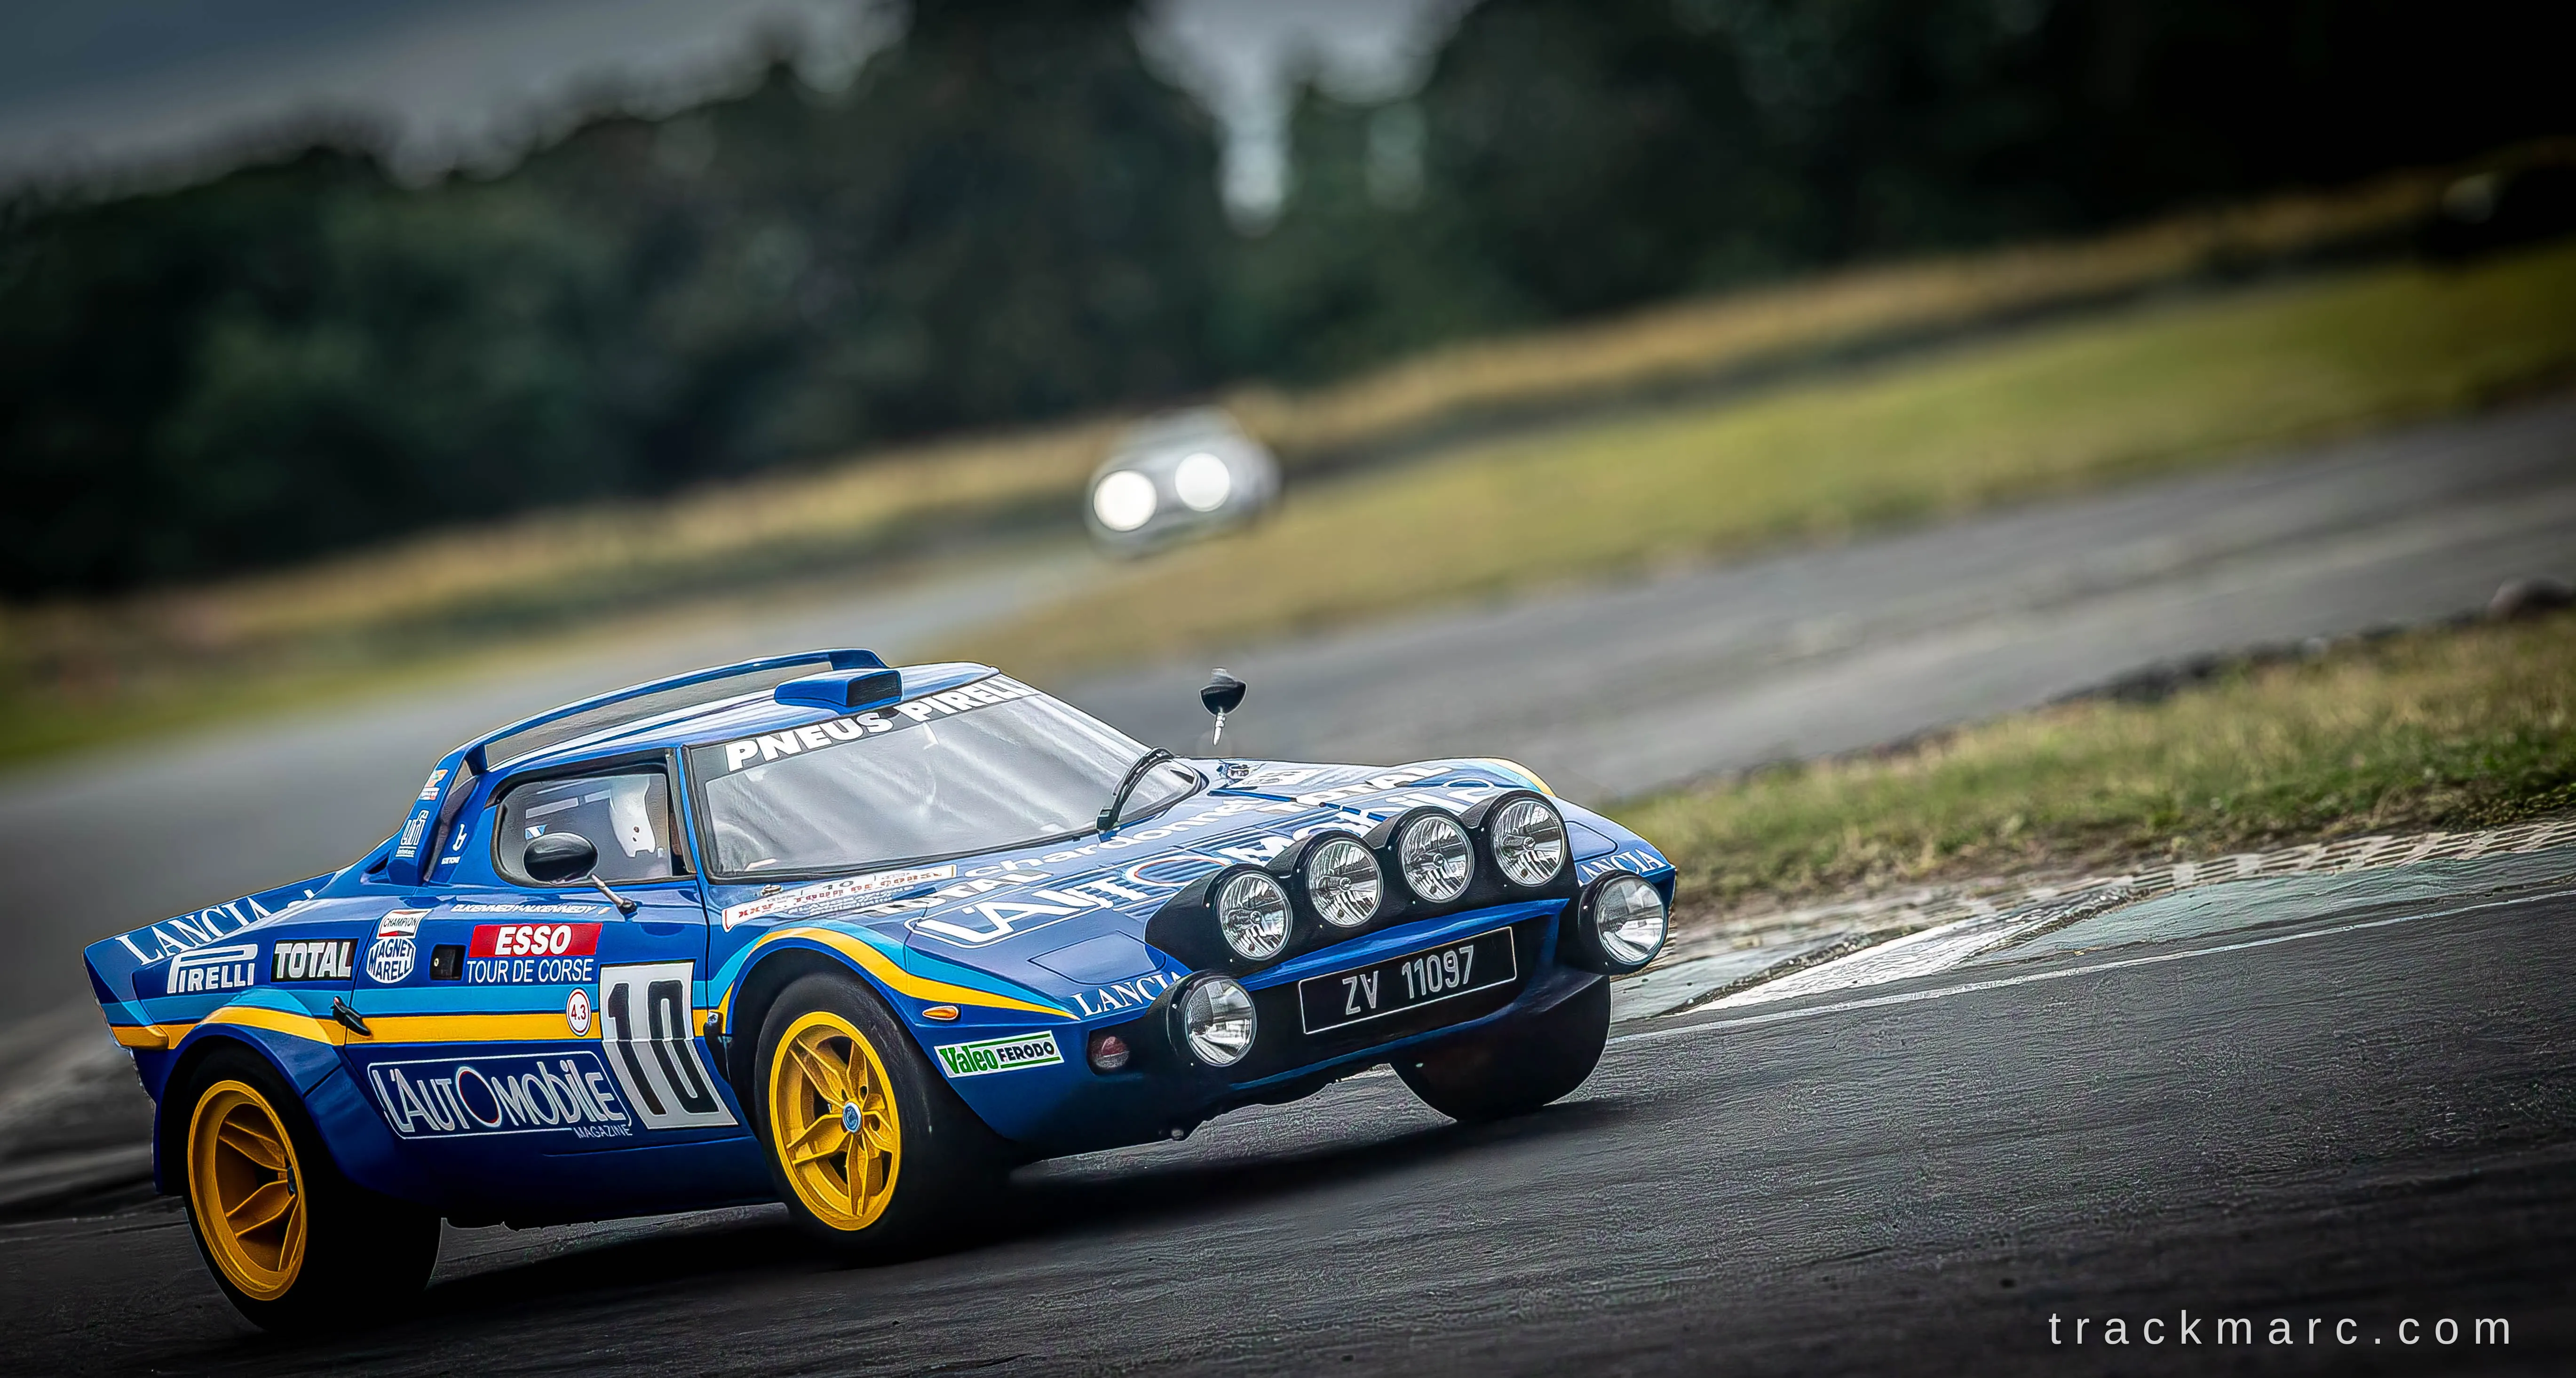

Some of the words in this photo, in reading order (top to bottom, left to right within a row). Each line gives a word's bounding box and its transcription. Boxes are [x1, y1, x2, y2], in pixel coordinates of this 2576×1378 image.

[725, 712, 894, 772] PNEUS
[893, 675, 1034, 722] PIRELLI
[1256, 767, 1452, 813] TOTAL
[1578, 848, 1667, 887] ANCIA
[852, 870, 1053, 915] TOTAL
[383, 917, 417, 927] CHAMPION
[368, 938, 414, 966] MAGNETI
[494, 925, 572, 956] ESSO
[167, 943, 258, 993] PIRELLI
[274, 941, 351, 979] TOTAL
[368, 952, 414, 981] MARELLI
[467, 959, 511, 983] TOUR
[513, 959, 534, 982] DE
[538, 958, 594, 982] CORSE
[1342, 970, 1379, 1016] ZV
[1402, 944, 1474, 999] 11097
[571, 1004, 587, 1020] 4.3
[608, 979, 720, 1115] 10
[939, 1045, 999, 1074] Valeo
[996, 1041, 1055, 1062] FERODO
[574, 1124, 633, 1139] MAGAZINE
